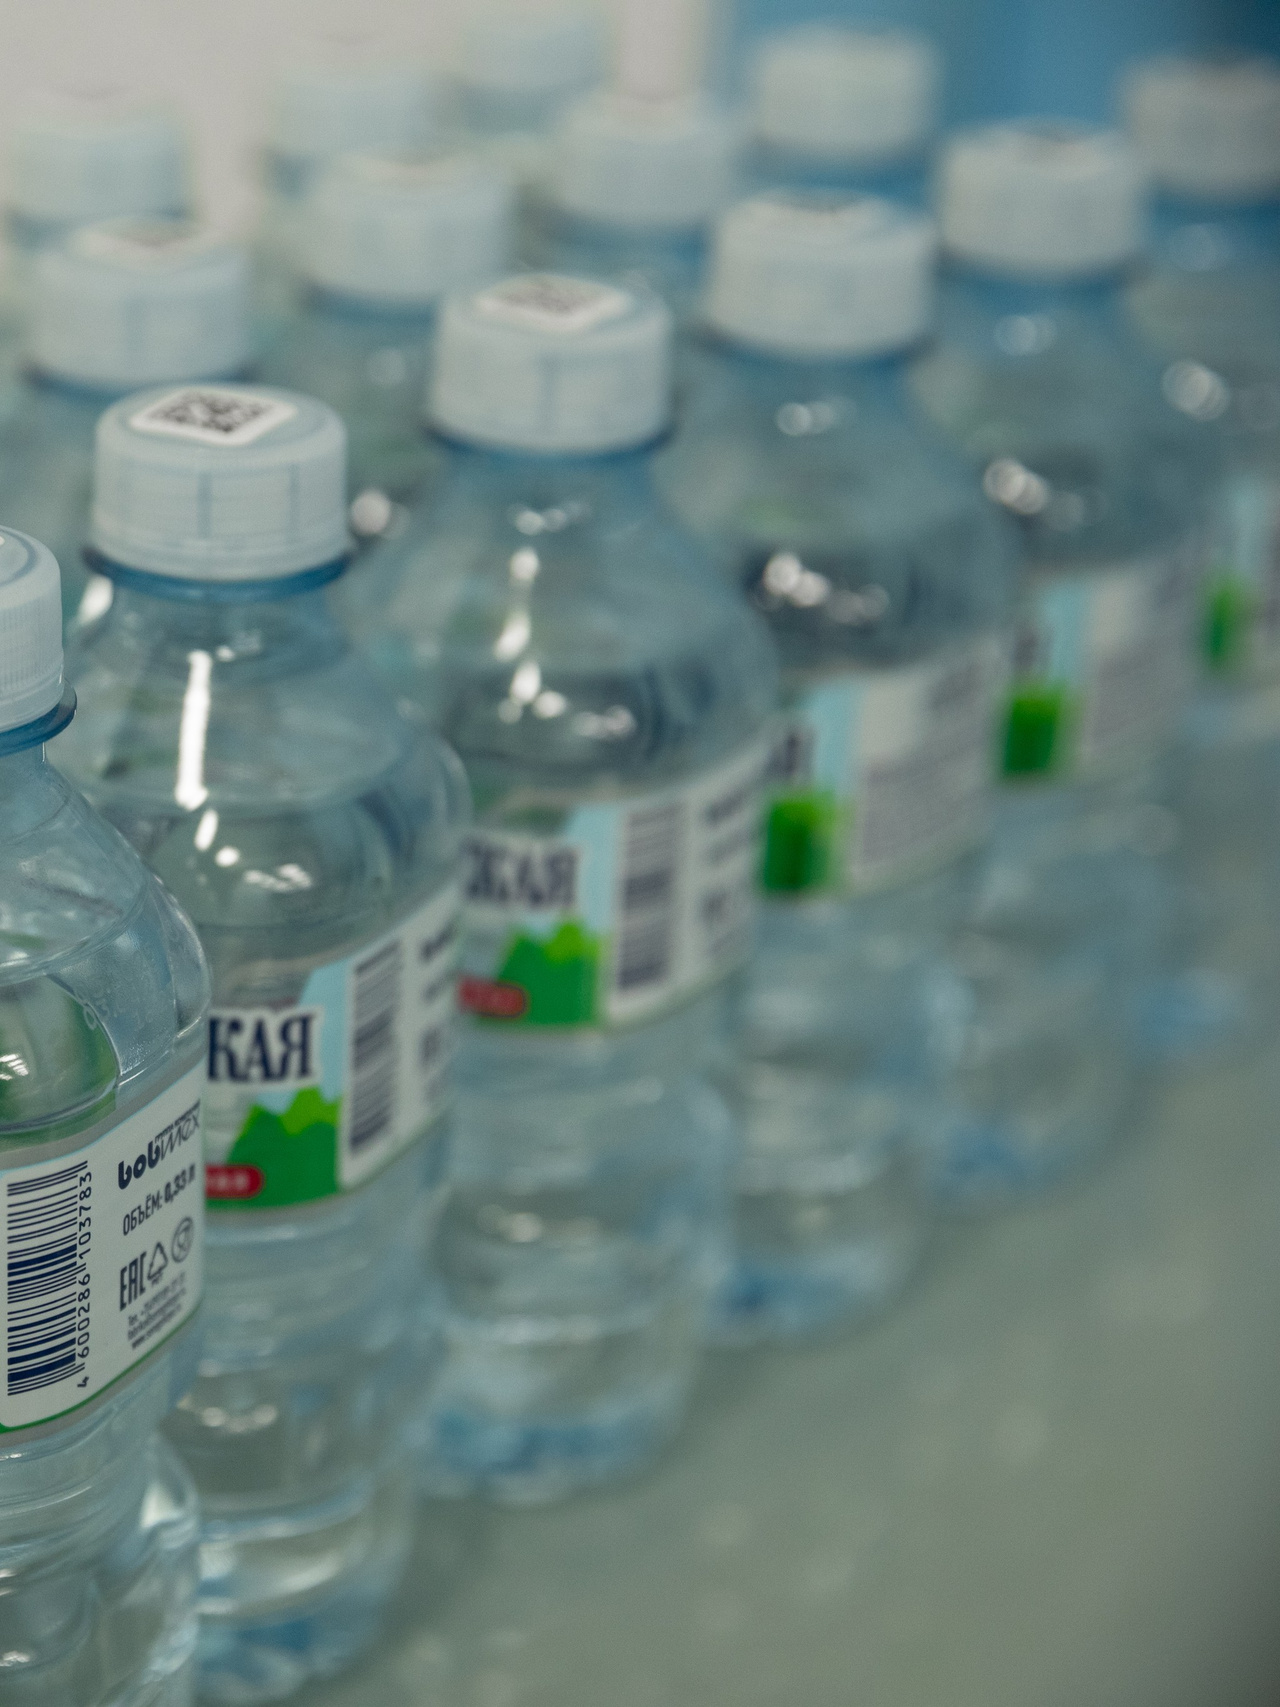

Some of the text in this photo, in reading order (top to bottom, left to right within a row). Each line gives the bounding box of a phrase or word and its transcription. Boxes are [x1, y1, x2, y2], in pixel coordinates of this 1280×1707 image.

[208, 1015, 313, 1084] КАЯ
[123, 1190, 163, 1236] ОБЪЁМ:
[76, 1171, 92, 1388] 4 600286 103783
